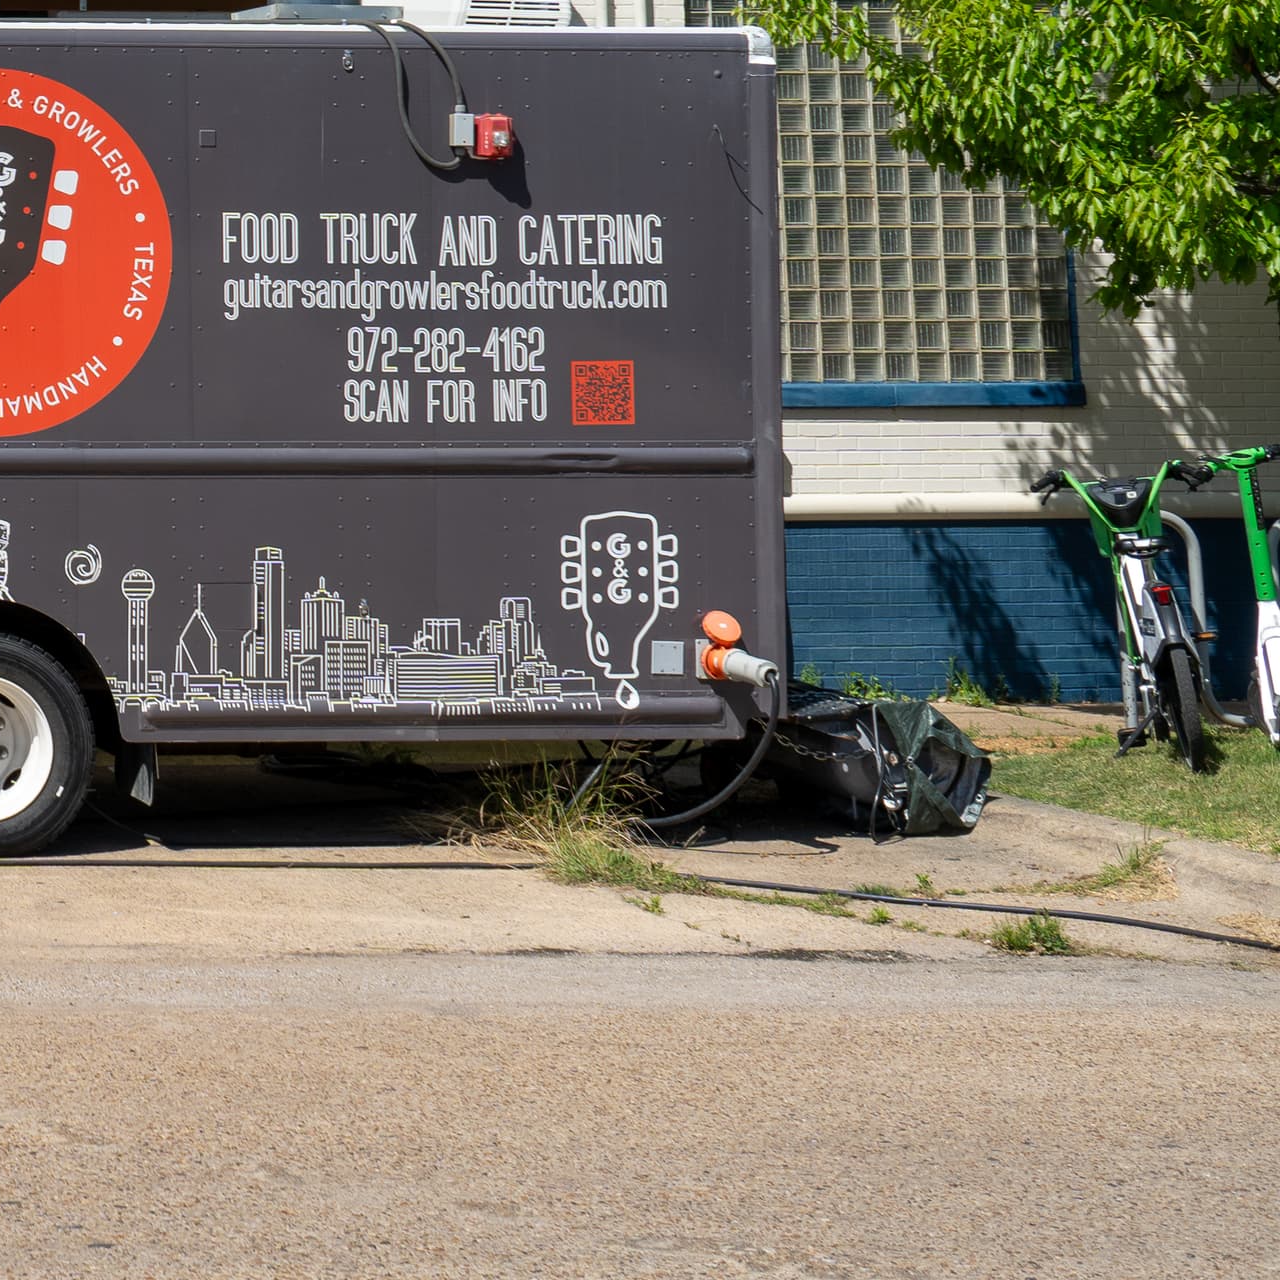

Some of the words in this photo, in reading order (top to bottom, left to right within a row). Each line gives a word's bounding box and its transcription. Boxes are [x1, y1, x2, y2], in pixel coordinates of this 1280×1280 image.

[7, 89, 24, 109] &
[32, 95, 139, 196] GROWLERS
[222, 212, 299, 265] FOOD
[319, 213, 418, 265] TRUCK
[438, 215, 497, 266] AND
[518, 214, 663, 265] CATERING
[123, 242, 154, 321] TEXAS
[223, 269, 668, 322] guitarsandgrowlersfoodtruck.com
[347, 326, 546, 372] 972-282-4162
[343, 379, 409, 423] SCAN
[427, 379, 476, 423] FOR
[493, 379, 548, 423] INFO
